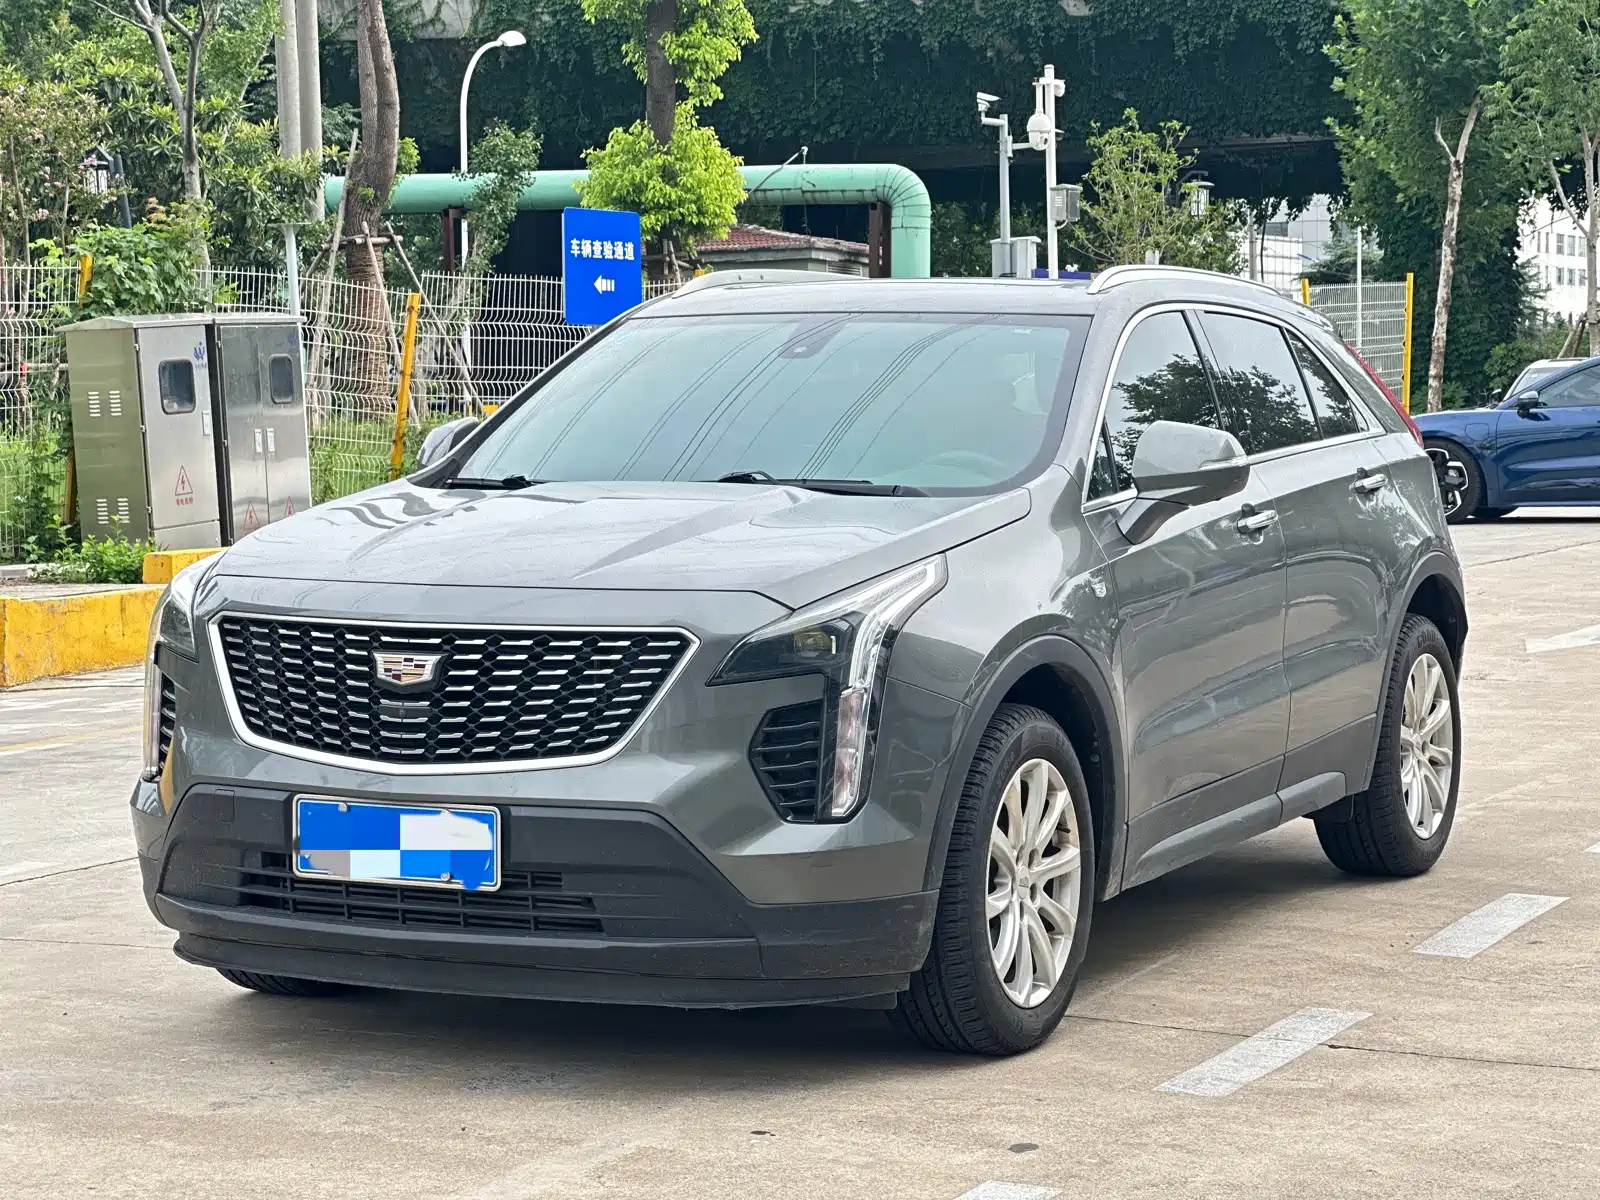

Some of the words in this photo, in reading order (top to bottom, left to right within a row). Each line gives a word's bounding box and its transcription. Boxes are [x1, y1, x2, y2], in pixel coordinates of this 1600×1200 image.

[570, 237, 635, 261] 车辆查验通道
